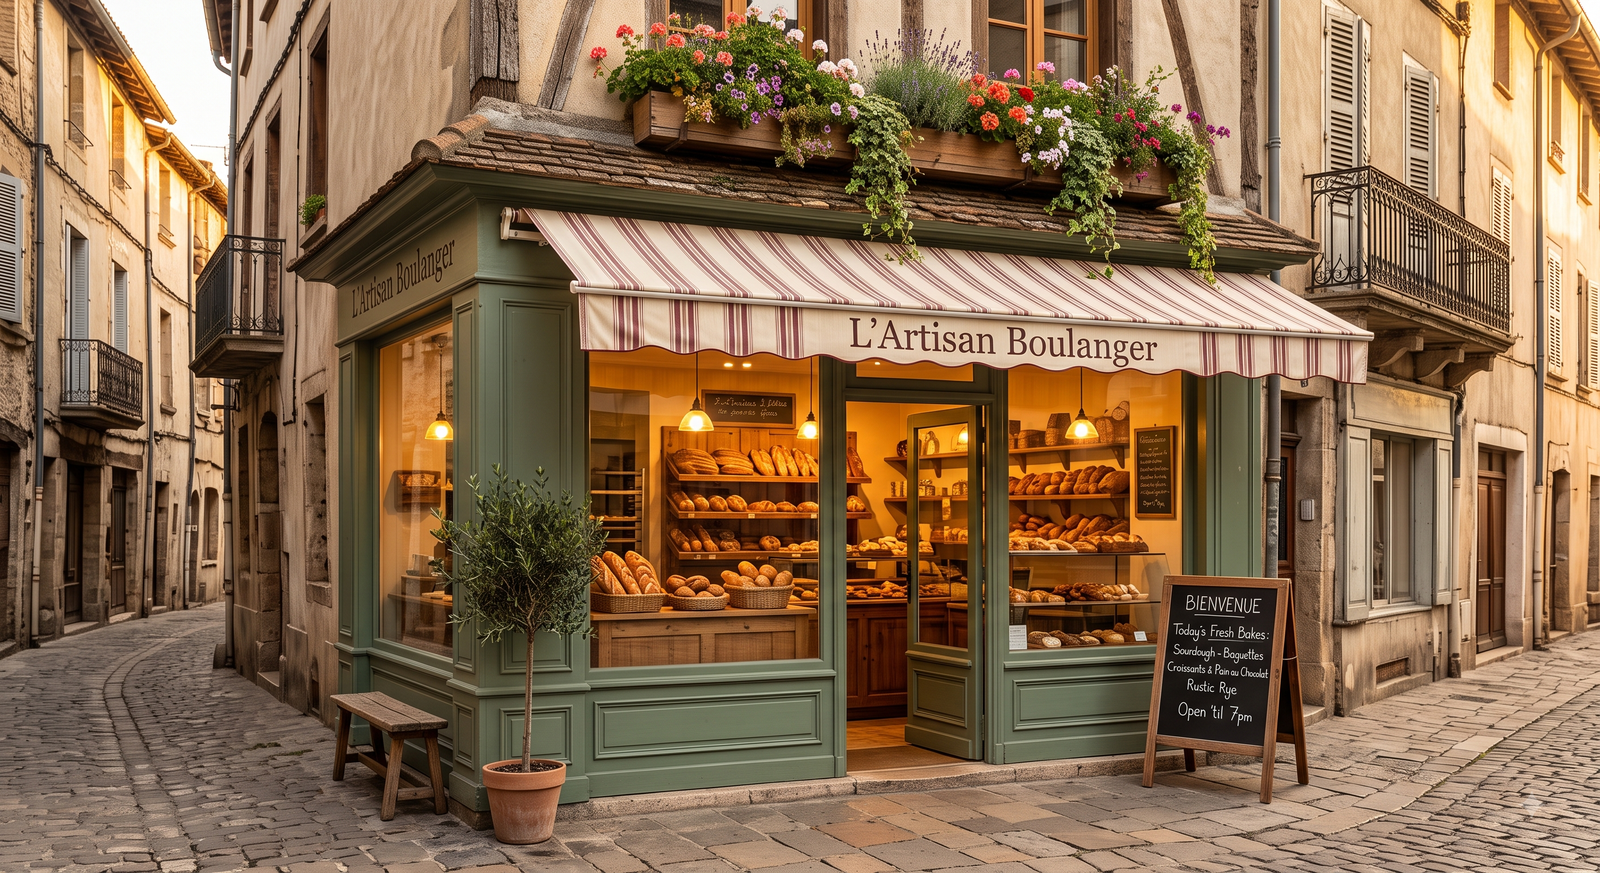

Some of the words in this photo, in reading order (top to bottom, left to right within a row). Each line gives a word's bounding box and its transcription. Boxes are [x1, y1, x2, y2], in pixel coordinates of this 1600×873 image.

[352, 275, 393, 318] L'Artisan
[396, 240, 455, 295] Boulanger
[849, 317, 996, 355] L'Artisan
[1006, 326, 1158, 368] Boulanger
[1186, 594, 1262, 613] BIENVENUE
[1173, 622, 1206, 641] Today's
[1210, 624, 1235, 638] Fresh
[1237, 625, 1270, 640] Bakes:
[1173, 643, 1216, 662] Sourdough
[1223, 646, 1264, 664] Baguettes
[1167, 661, 1206, 674] Croissants
[1207, 665, 1213, 675] &
[1214, 663, 1230, 677] Pain
[1230, 669, 1240, 677] au
[1240, 666, 1269, 679] Chocolat
[1186, 678, 1215, 693] Rustic
[1219, 681, 1238, 700] Rye
[1177, 701, 1207, 721] Open
[1210, 704, 1224, 720] 'til
[1229, 705, 1253, 727] 7pm
